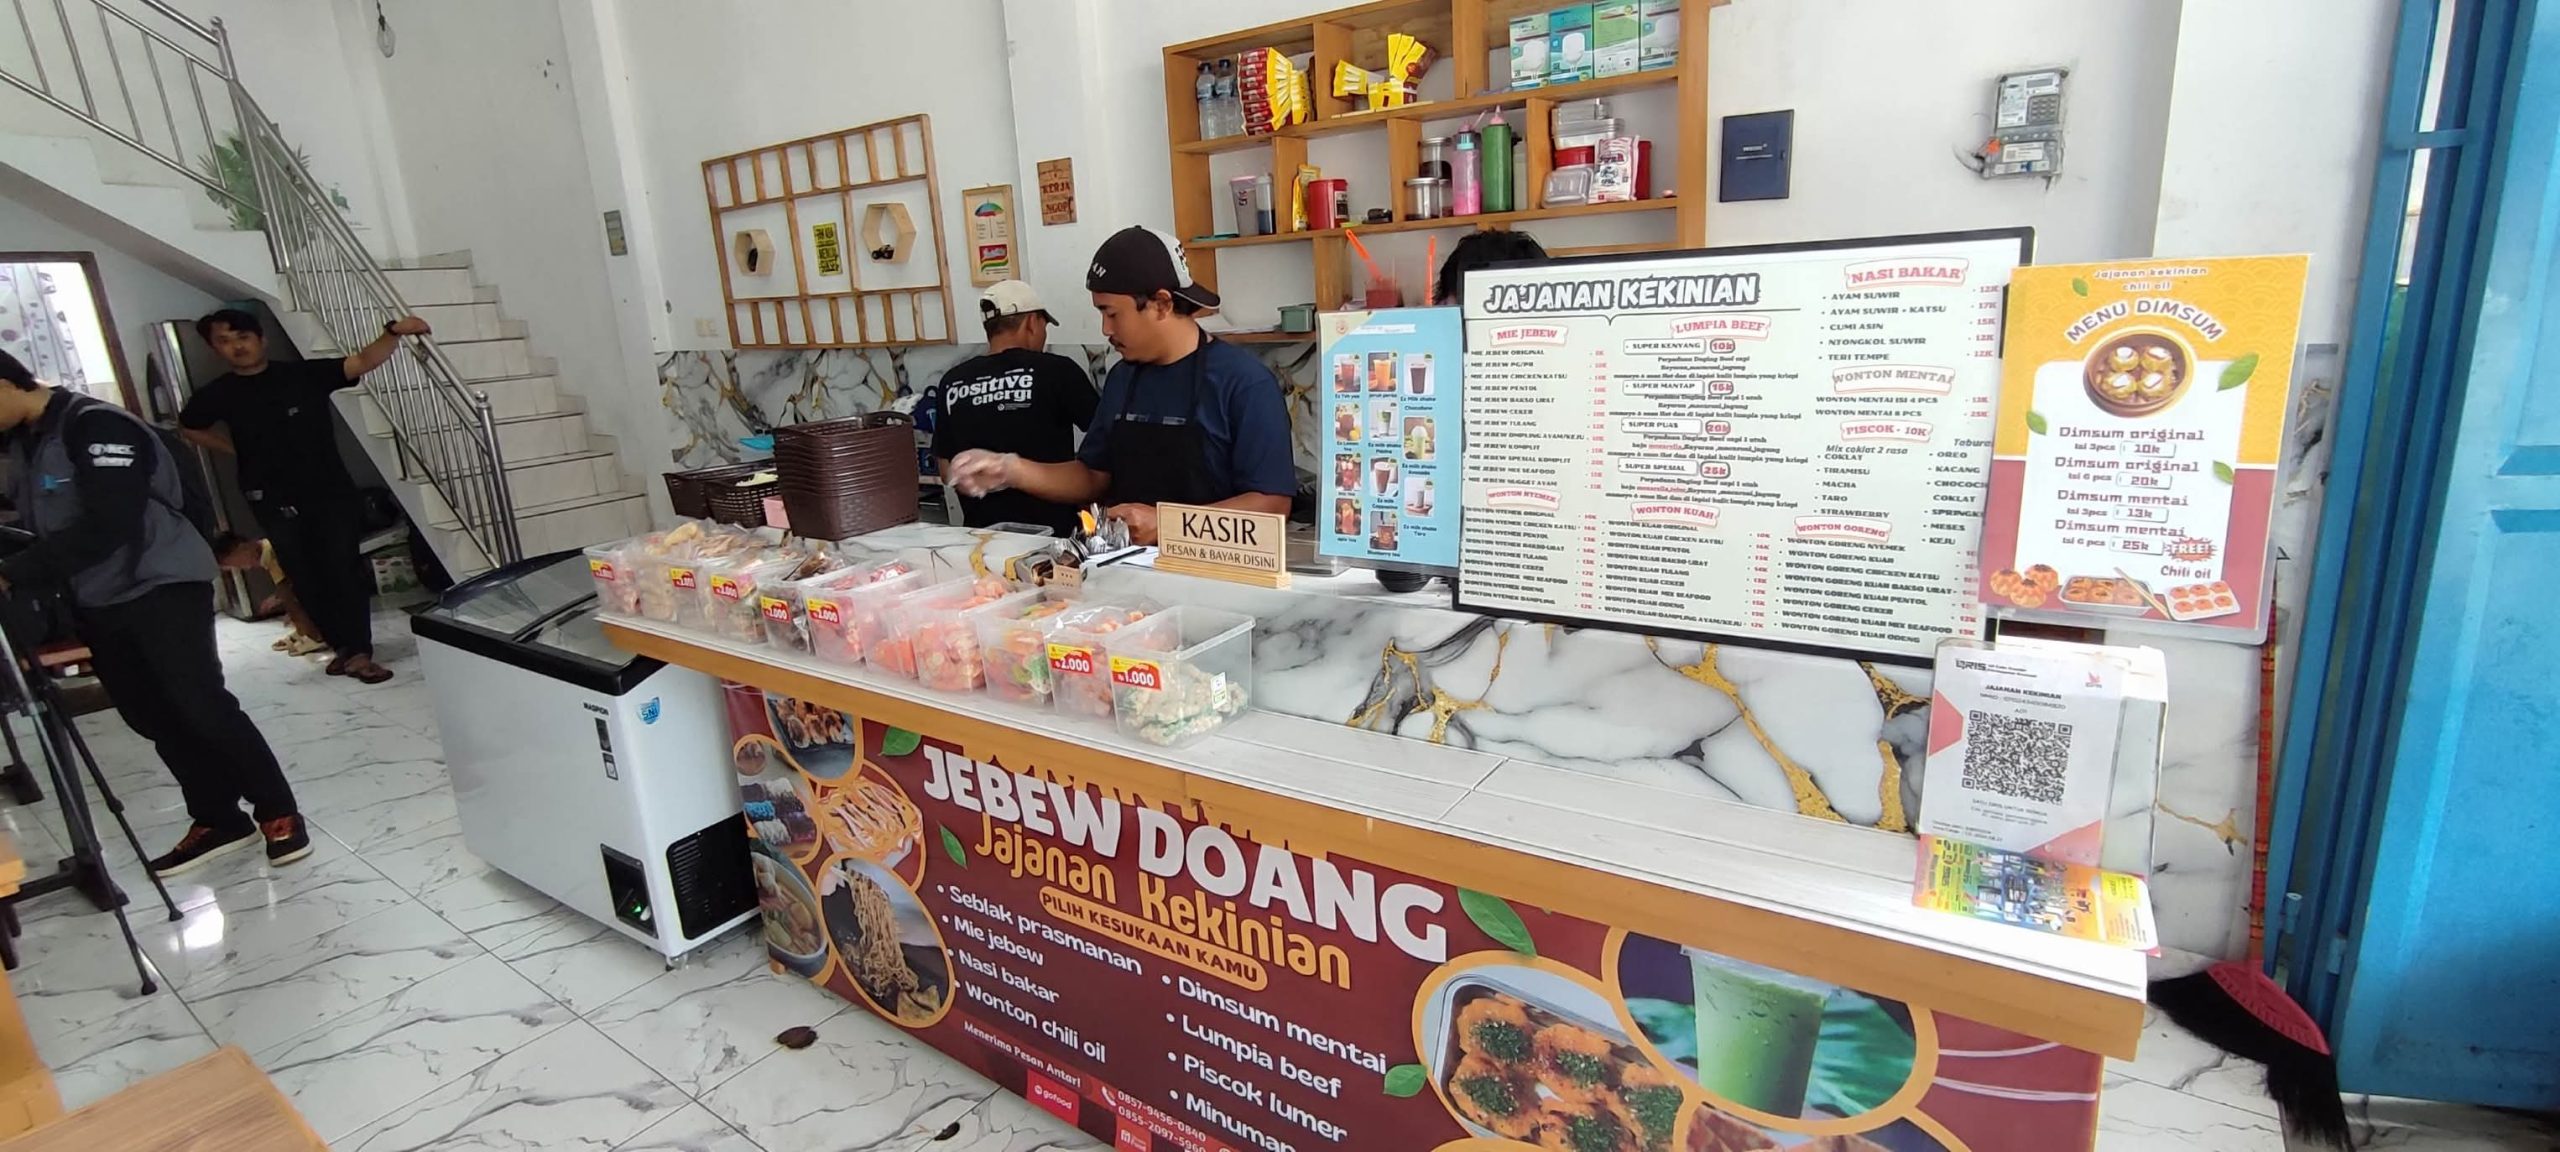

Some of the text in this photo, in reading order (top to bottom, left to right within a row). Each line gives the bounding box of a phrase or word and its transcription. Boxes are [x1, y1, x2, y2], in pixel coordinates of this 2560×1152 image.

[1852, 266, 1960, 283] NASI BAKAR
[2095, 267, 2207, 279] Jajanan kekinian
[1485, 273, 1760, 312] JAJANAN KEKINIAN
[2123, 282, 2170, 291] chili oil
[1832, 292, 1900, 300] AYAM SUWIR
[1830, 308, 1860, 316] AYAM
[1862, 307, 1899, 315] SUWIR
[1676, 320, 1765, 333] LUMPIA BEEF
[2066, 300, 2223, 342] MENU DIMSUM
[1497, 328, 1558, 340] MIE JEBEW
[1833, 370, 1954, 384] WONTON MENTAI
[1846, 424, 1928, 437] PISCOK 10K
[2060, 427, 2204, 443] Dimsum original
[1826, 445, 1843, 453] Mix
[1845, 445, 1876, 454] coklat
[1878, 446, 1884, 454] 2
[2134, 444, 2160, 454] 10k
[1653, 464, 1685, 472] SPESIAL
[1824, 468, 1870, 476] TIRAMISU
[1936, 466, 1980, 474] KACANG
[2056, 457, 2199, 474] Dimsum original
[1822, 481, 1857, 489] MACHA
[2130, 476, 2159, 486] 20k
[1933, 494, 1976, 502] COKLAT
[2058, 490, 2189, 506] Dimsum mentai
[1636, 506, 1715, 520] WONTON KUAH
[1820, 508, 1890, 518] STRAWBERRY
[2128, 508, 2153, 519] 13k
[1182, 512, 1258, 546] KASIR
[1798, 524, 1886, 538] WONTON GORENG
[2056, 520, 2186, 538] Dimsum mentai
[1788, 538, 1829, 546] WONTON
[1832, 540, 1866, 549] GORENG
[2122, 540, 2149, 551] 25k
[2171, 542, 2210, 555] FREE!
[1166, 544, 1275, 568] PESAN & BAYAR DISINI
[2160, 565, 2211, 579] Chili oil
[1060, 657, 1091, 673] 2.000
[1956, 659, 1987, 671] QRIS
[1124, 670, 1155, 687] 1.000
[922, 744, 1448, 962] JEBEW DOANG
[974, 811, 1351, 990] Jajanan Kekinian
[950, 885, 1143, 976] Seblak prasmanan
[1042, 892, 1258, 983] PILIH KESUKAAN KAMU
[954, 916, 1044, 967] Mie jebew
[959, 949, 1060, 1005] Nasi bakar
[965, 980, 1106, 1064] Wonton chili oil
[1178, 976, 1387, 1075] Dimsum mentai
[964, 1020, 1013, 1053] Menerima
[1014, 1046, 1044, 1069] Pesan
[1182, 1014, 1342, 1099] Lumpia beef
[1042, 1089, 1072, 1110] gofood
[1184, 1052, 1348, 1143] Piscok lumer
[1118, 1090, 1207, 1142] 0857-9456-0840
[1186, 1092, 1297, 1152] Minuman
